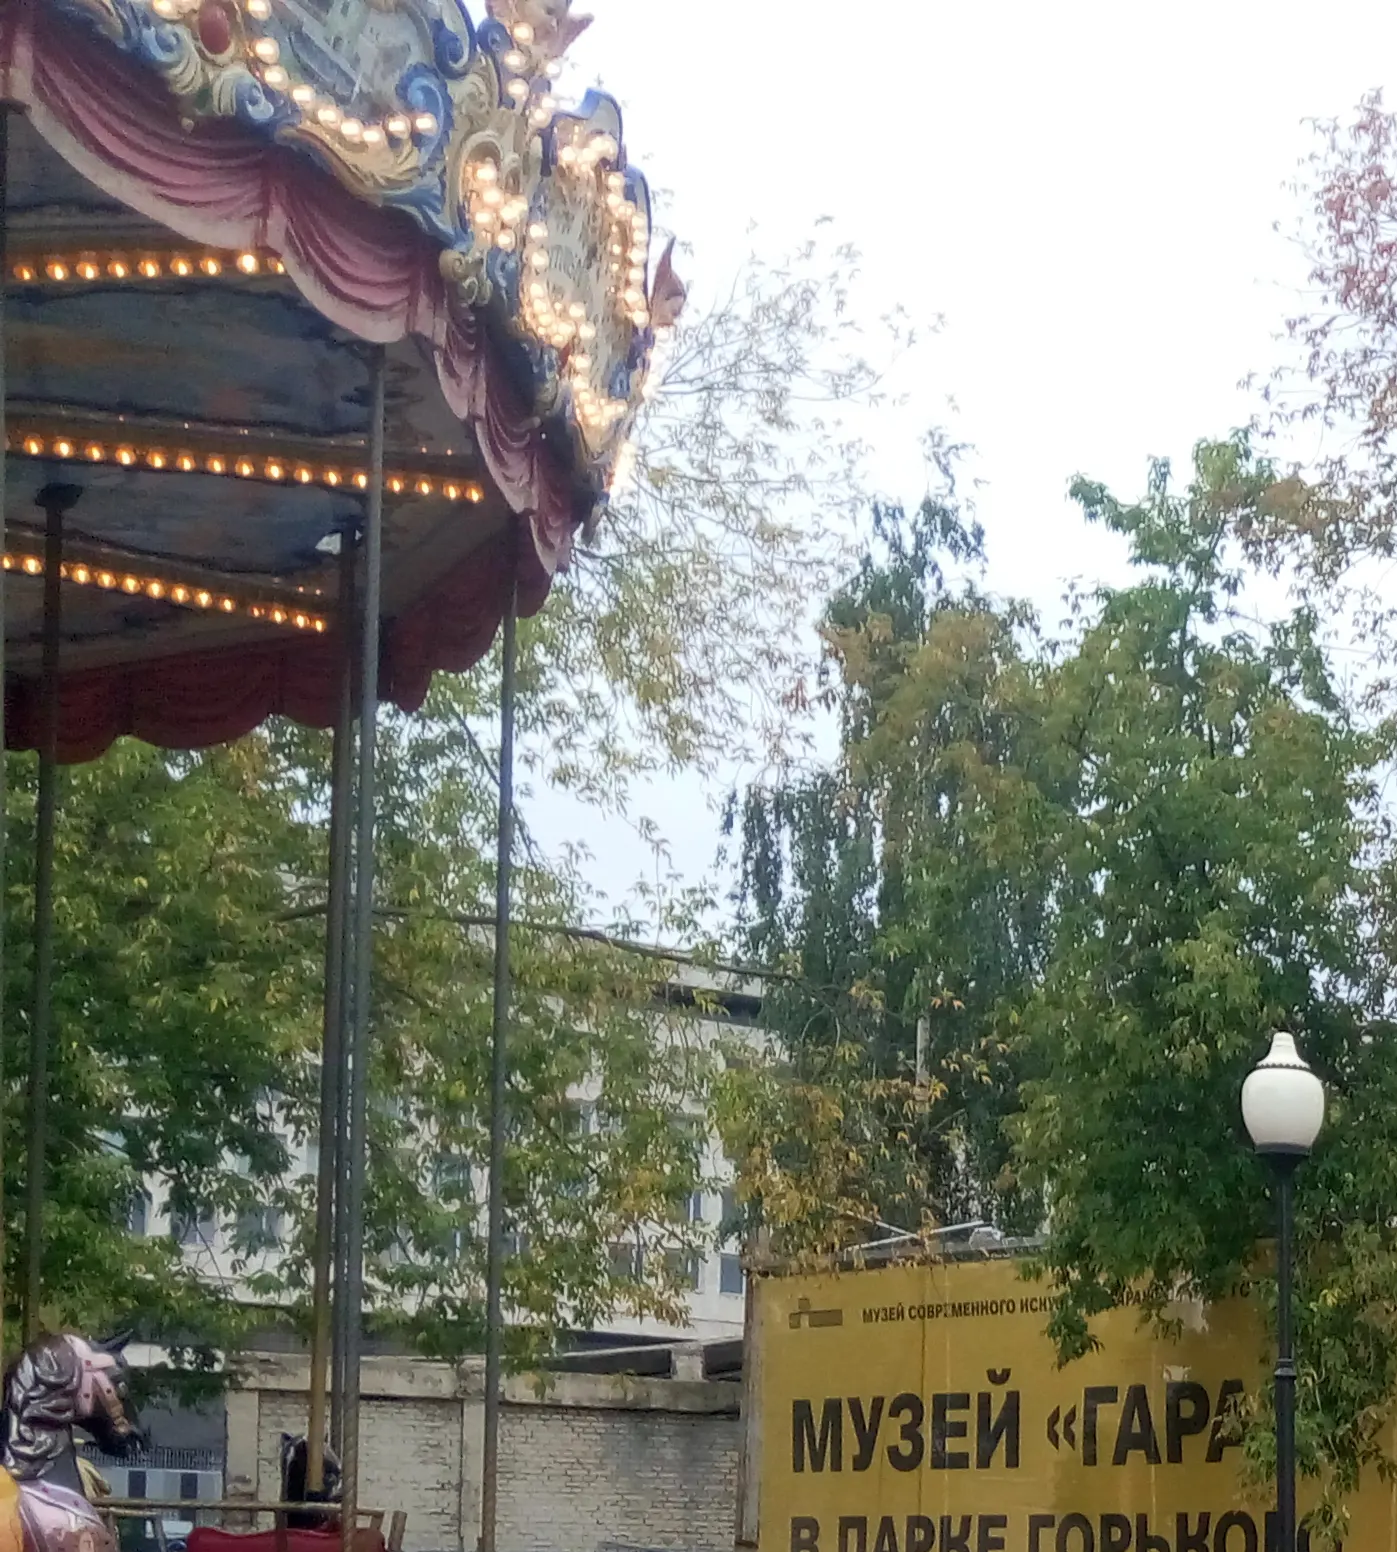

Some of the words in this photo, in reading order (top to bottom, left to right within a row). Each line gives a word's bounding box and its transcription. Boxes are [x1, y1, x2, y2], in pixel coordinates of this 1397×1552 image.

[862, 1302, 905, 1324] МУЗЕЙ
[792, 1368, 1020, 1473] МУЗЕЙ
[1045, 1379, 1246, 1467] «ГАРА
